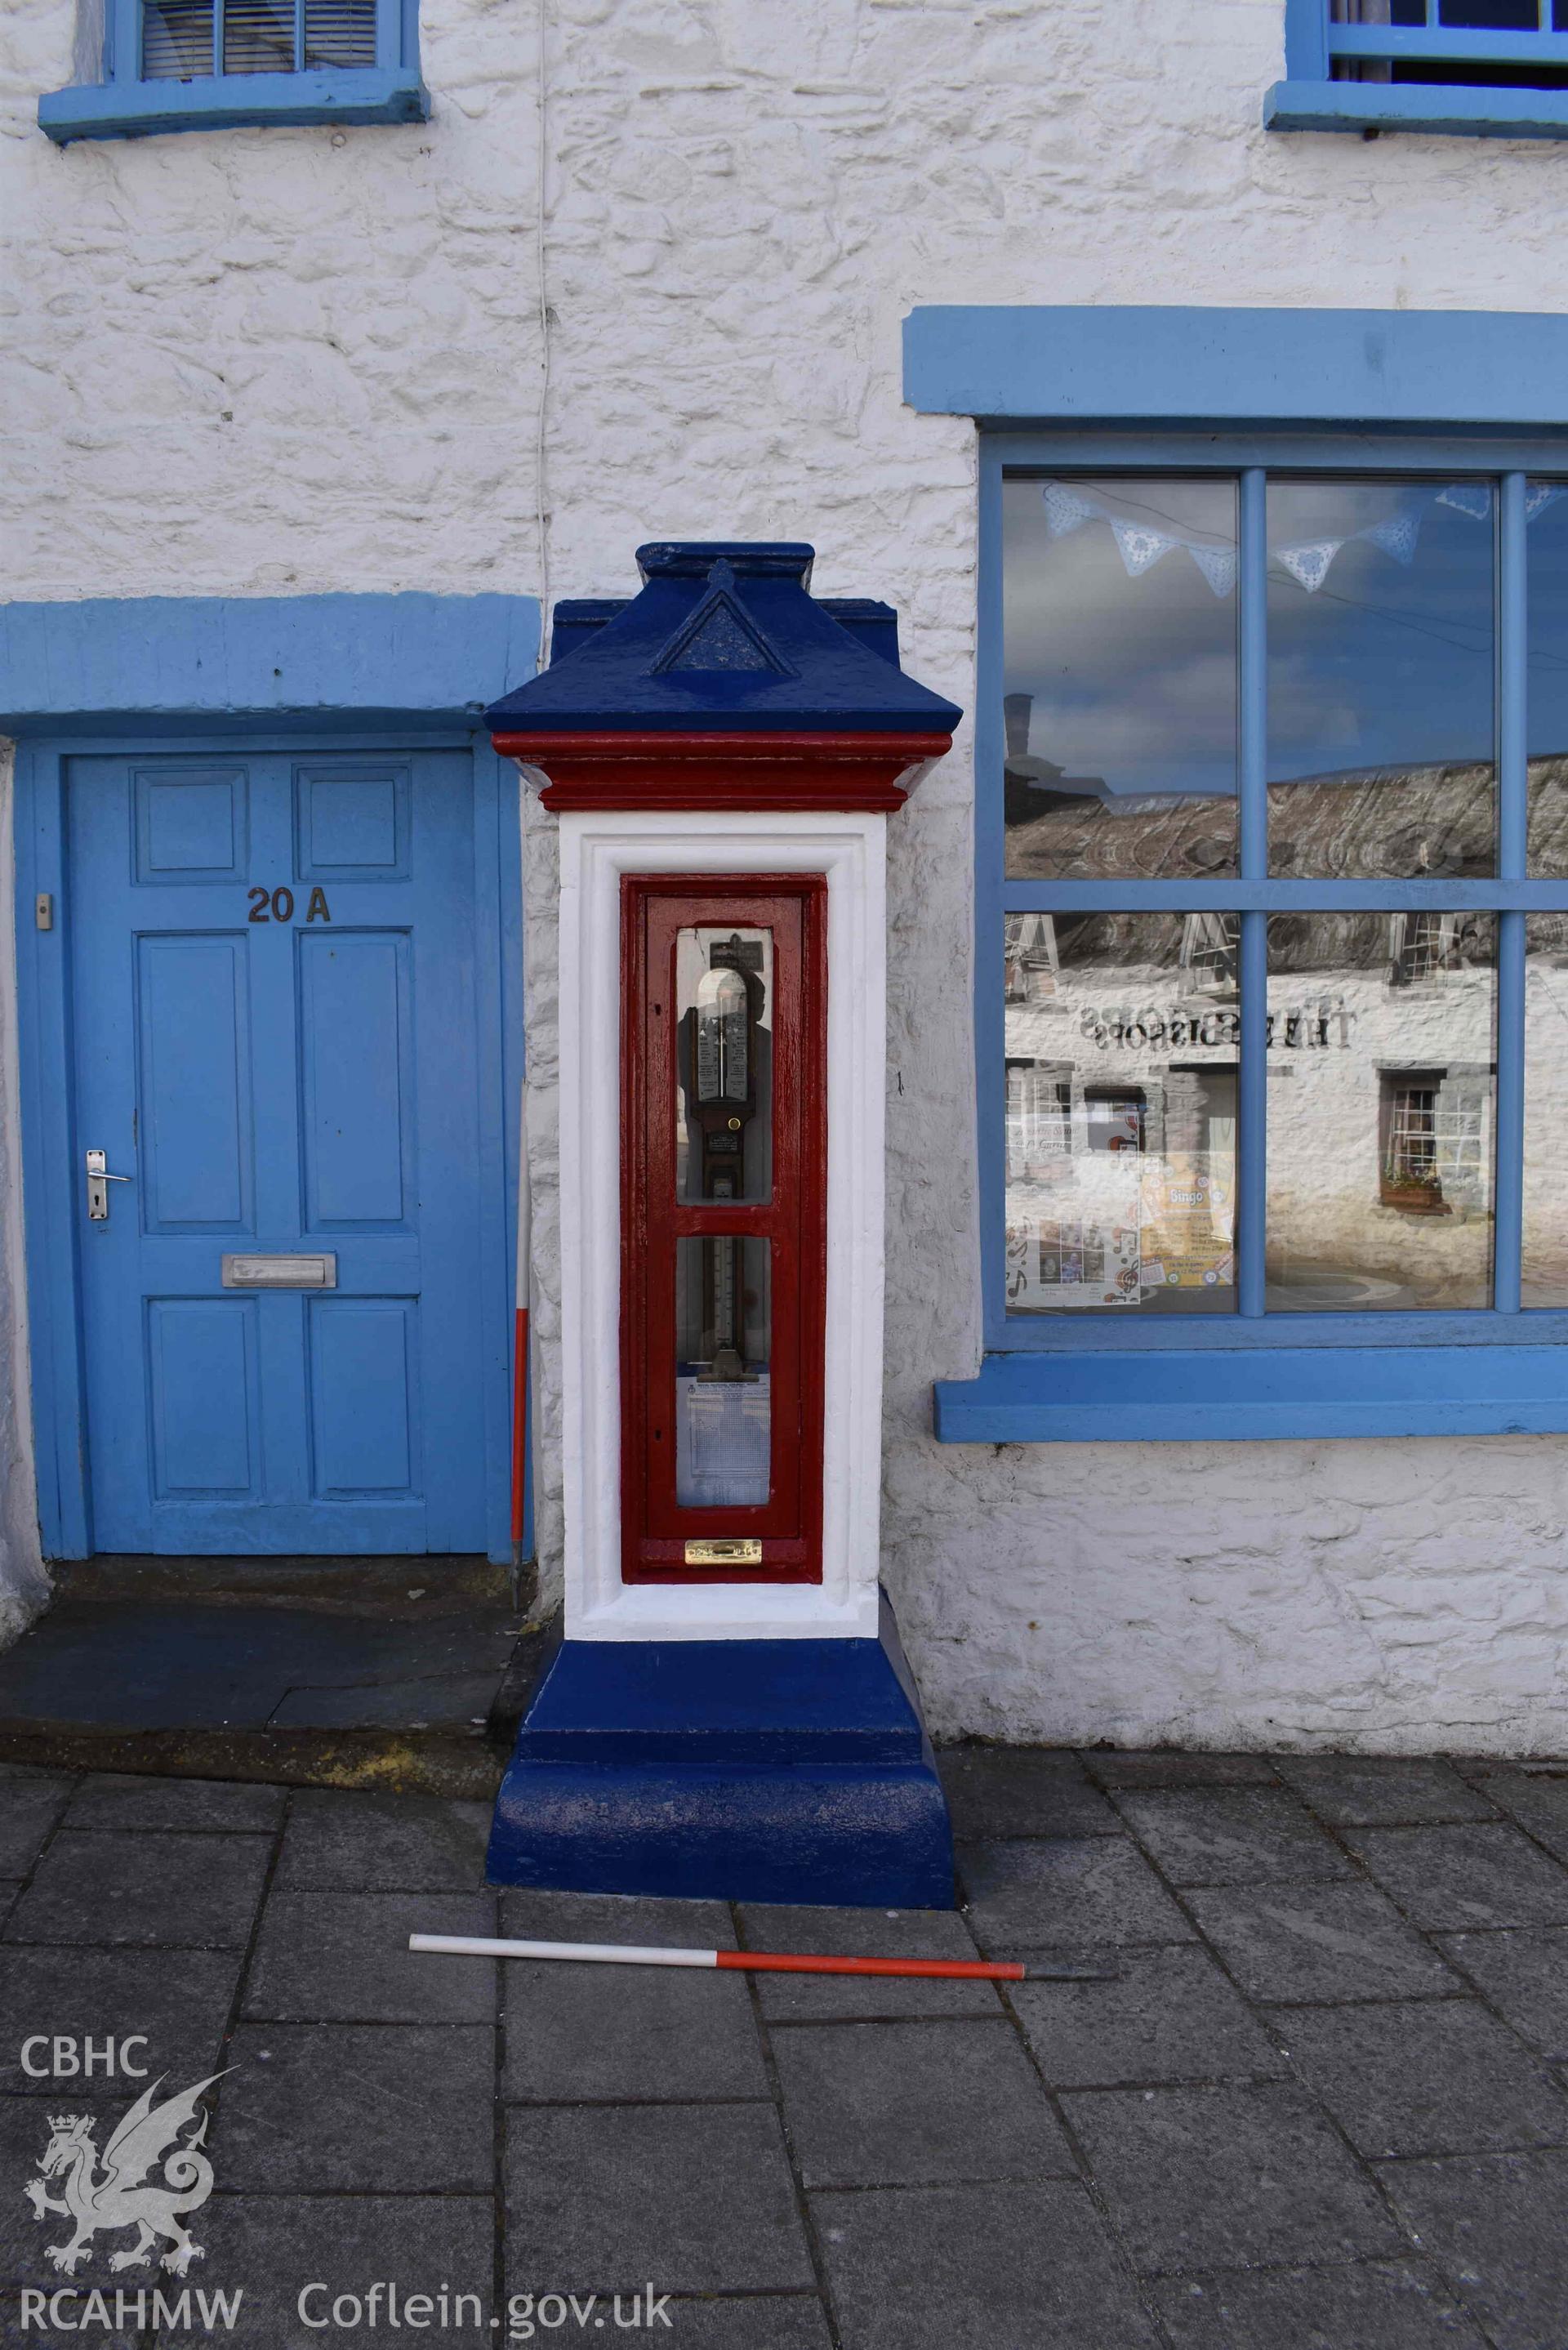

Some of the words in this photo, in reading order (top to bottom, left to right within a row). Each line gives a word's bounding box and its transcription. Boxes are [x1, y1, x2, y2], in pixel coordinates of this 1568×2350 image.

[247, 886, 293, 922] 20
[306, 886, 331, 922] A
[1170, 1188, 1203, 1207] Bingo
